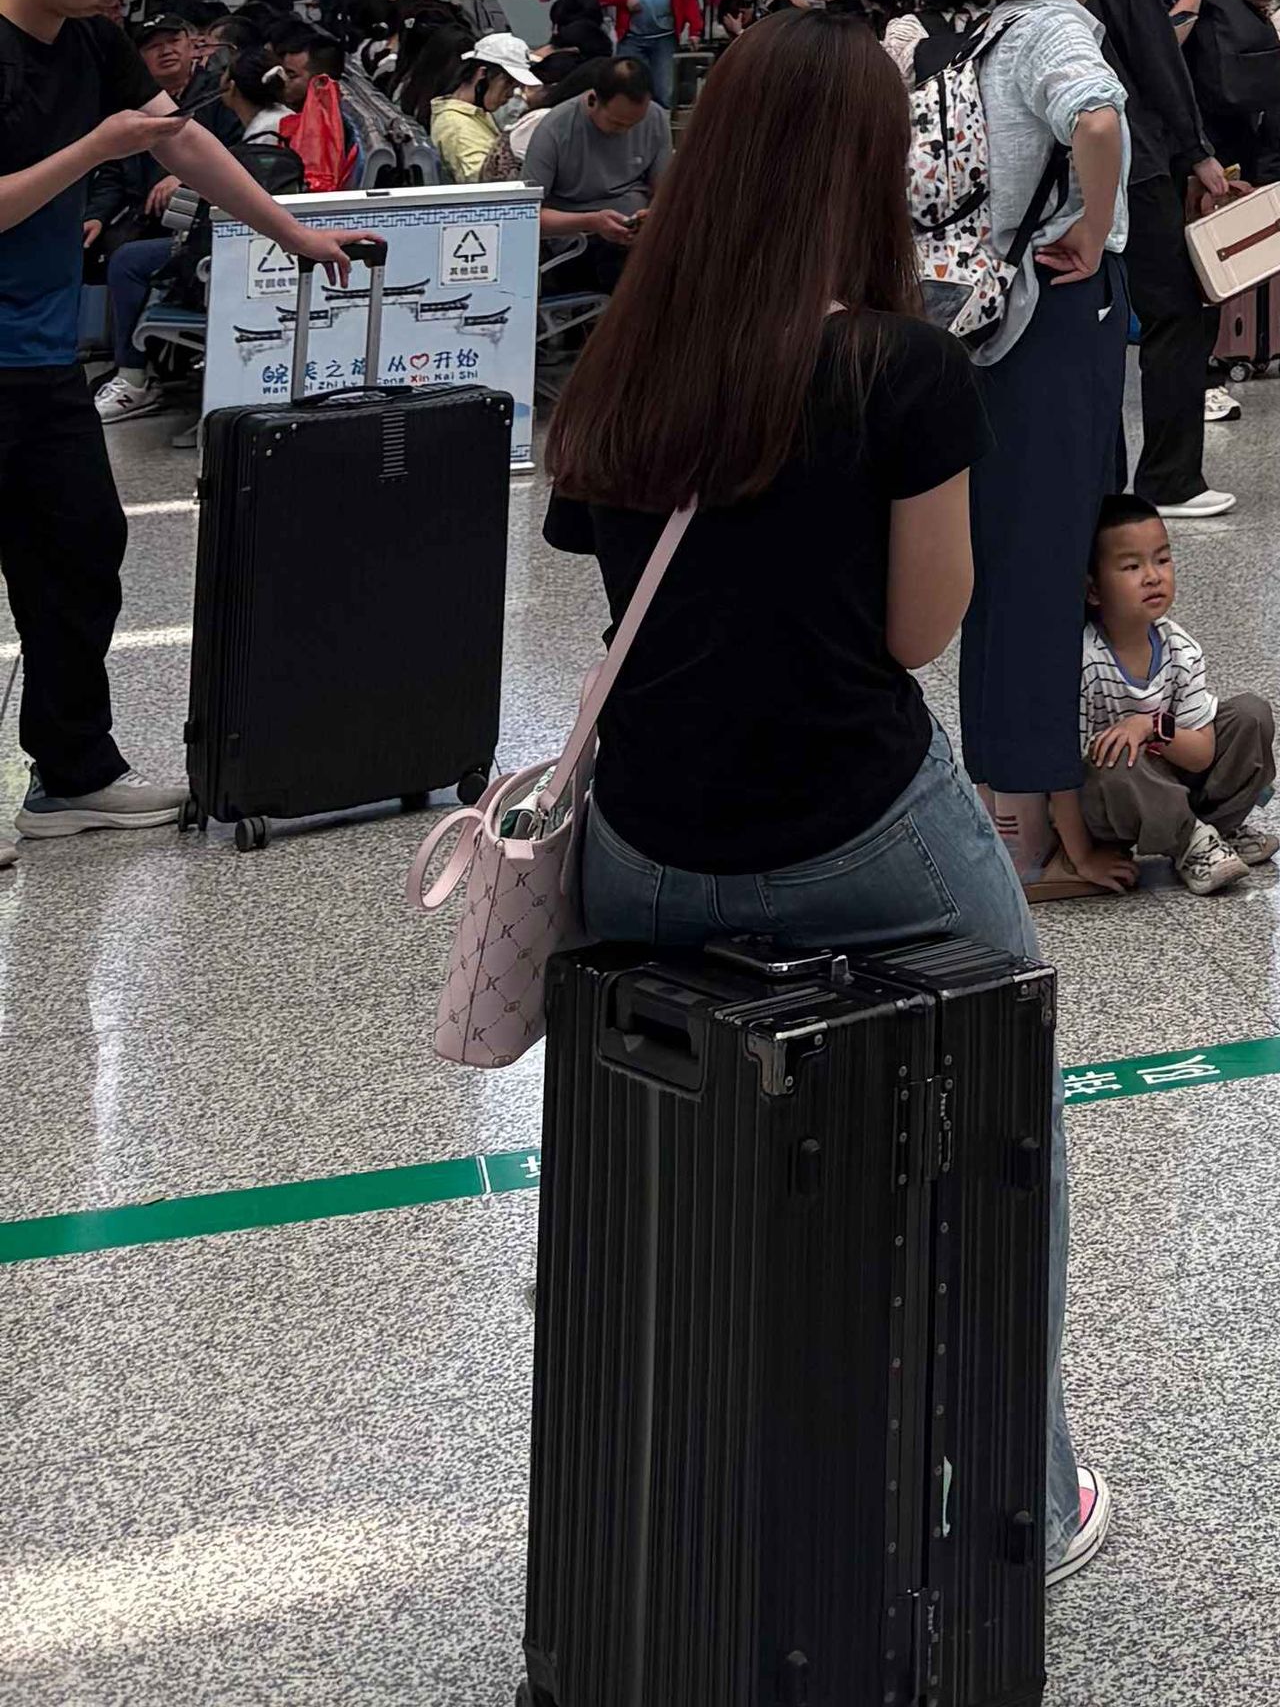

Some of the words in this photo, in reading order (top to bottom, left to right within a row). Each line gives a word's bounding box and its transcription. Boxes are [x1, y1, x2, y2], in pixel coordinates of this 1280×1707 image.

[434, 348, 479, 369] 开始
[411, 374, 429, 384] Xin
[459, 370, 479, 380] Shi
